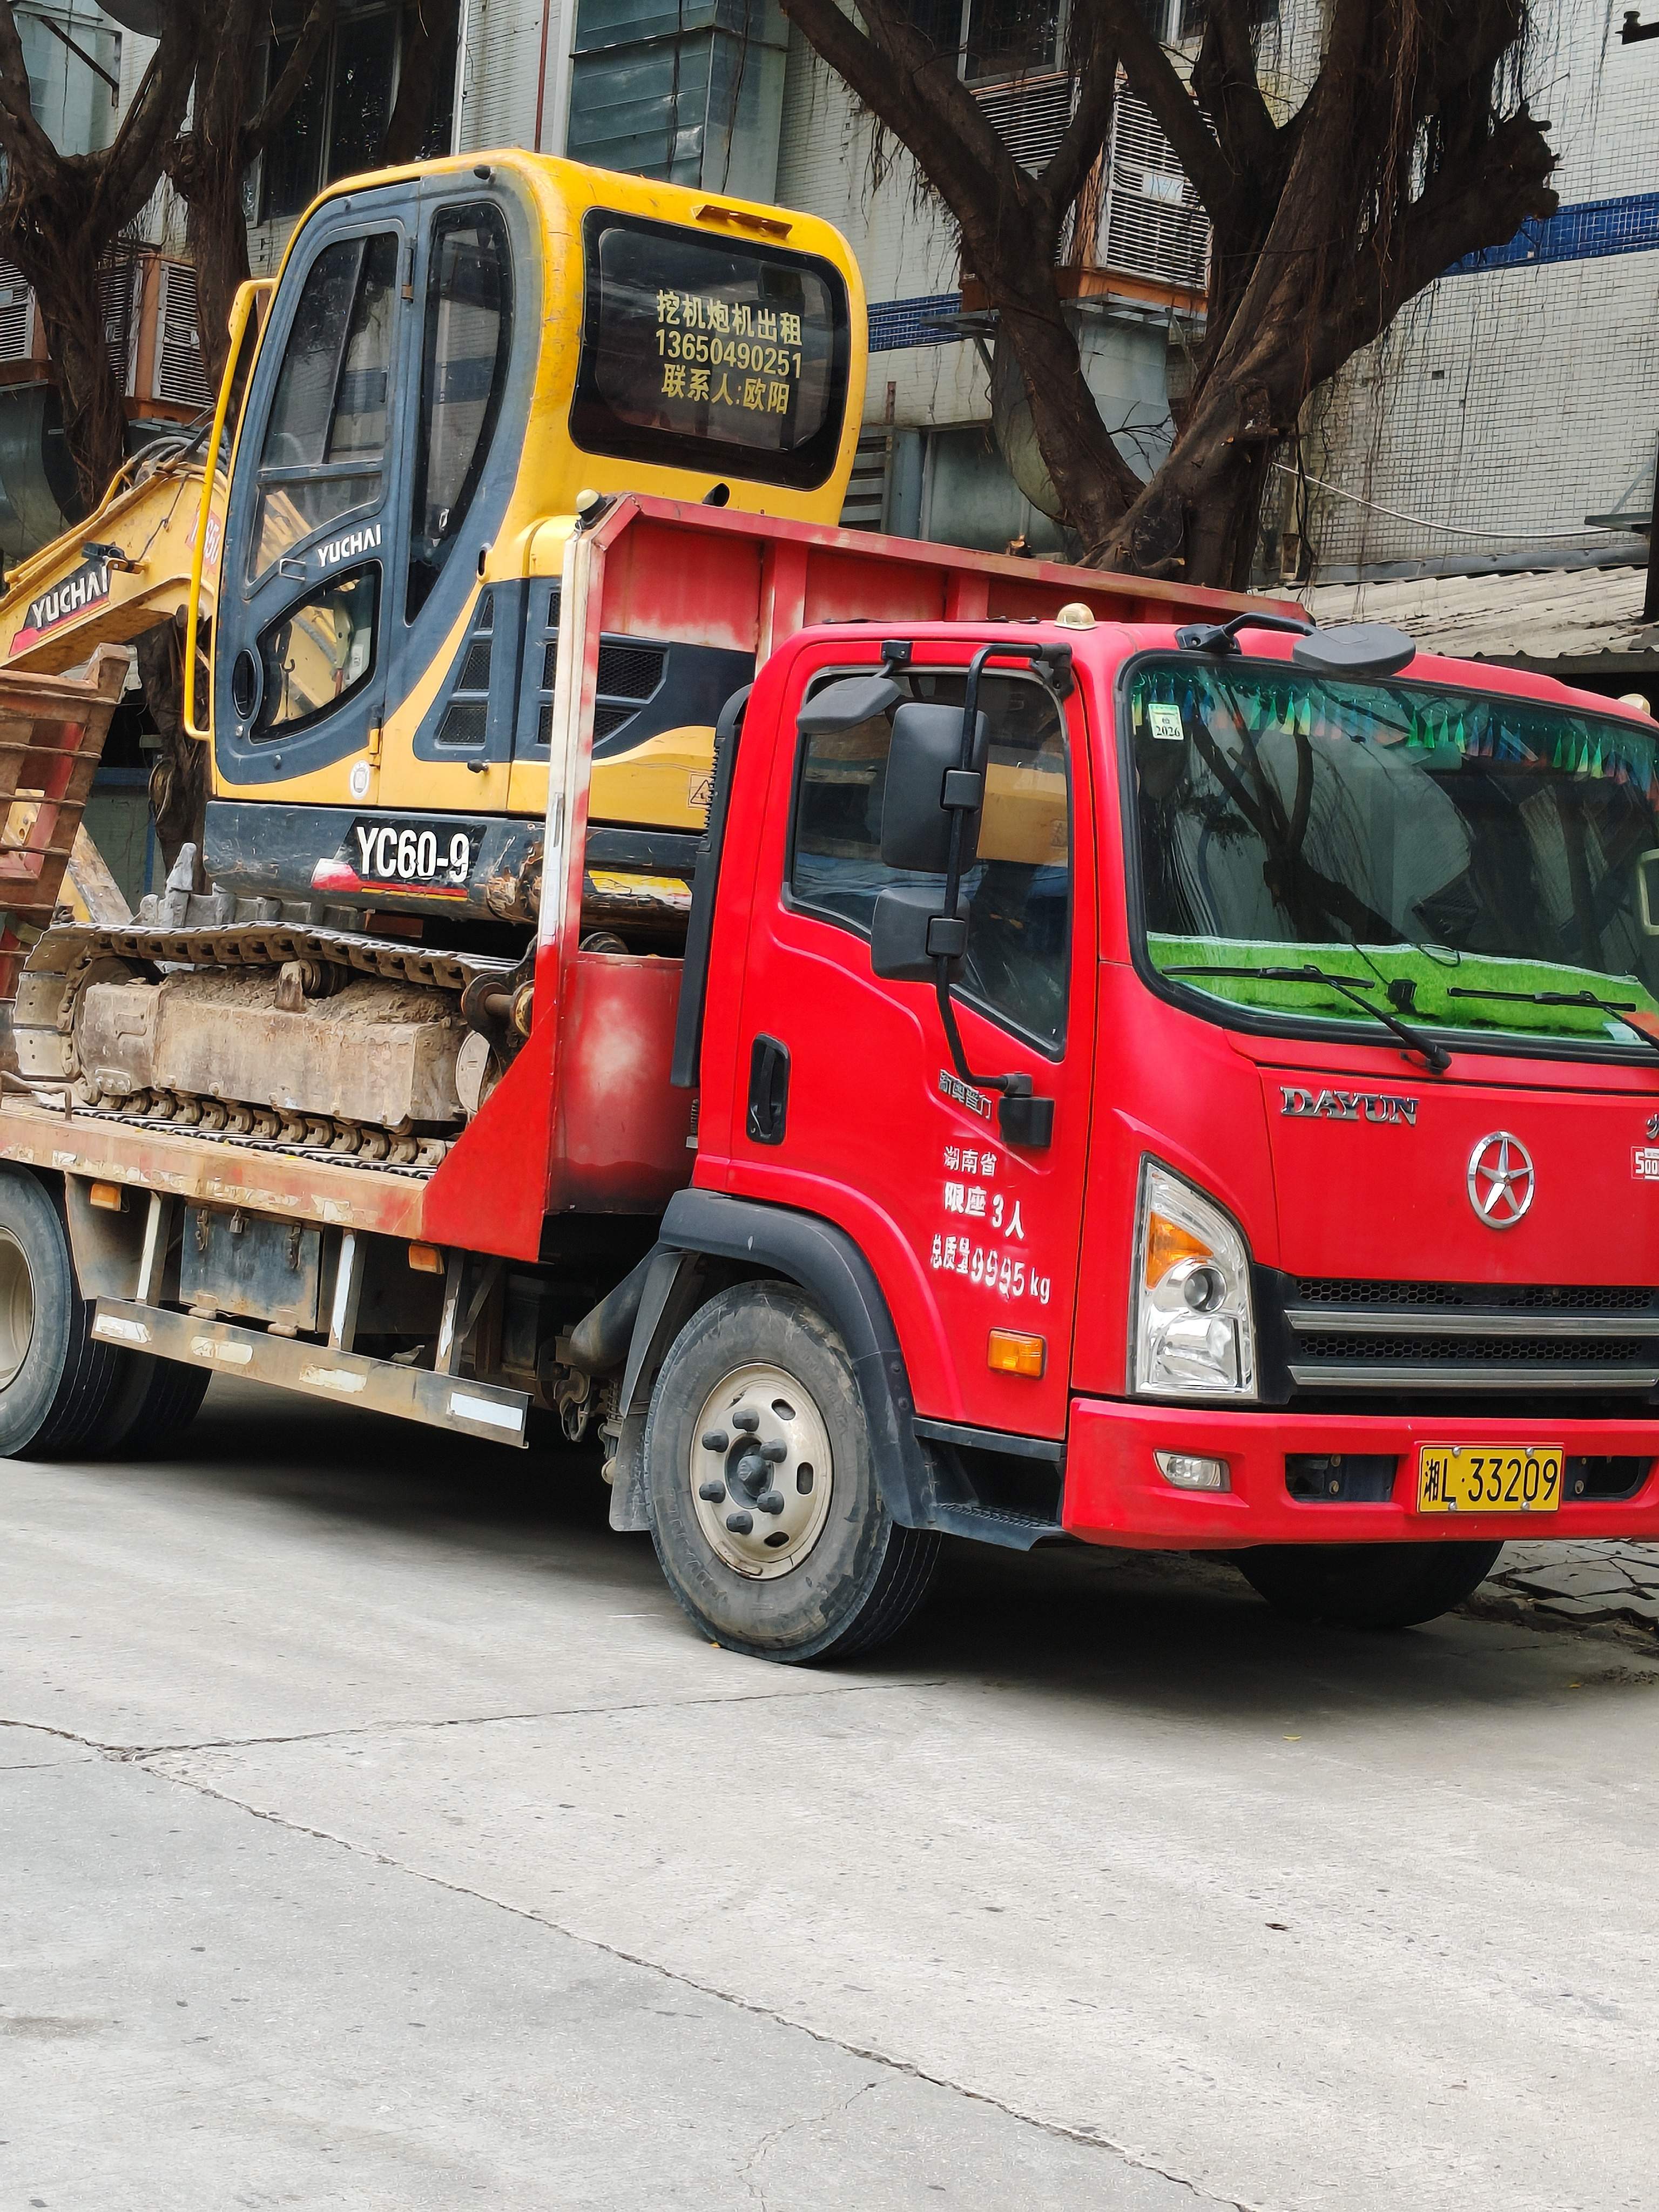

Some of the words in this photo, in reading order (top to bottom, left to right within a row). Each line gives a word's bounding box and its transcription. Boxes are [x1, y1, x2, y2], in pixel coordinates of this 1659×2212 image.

[657, 289, 802, 346] 挖机炮机出租
[656, 329, 801, 379] 13650490251
[661, 363, 790, 414] 联系人:欧阳
[318, 524, 381, 568] YUCHAI
[32, 565, 108, 628] YUCHAI
[1156, 725, 1180, 737] 2026
[356, 826, 469, 883] YC60-9
[1279, 1086, 1419, 1127] DAYUN
[943, 1145, 997, 1177] 湖南省
